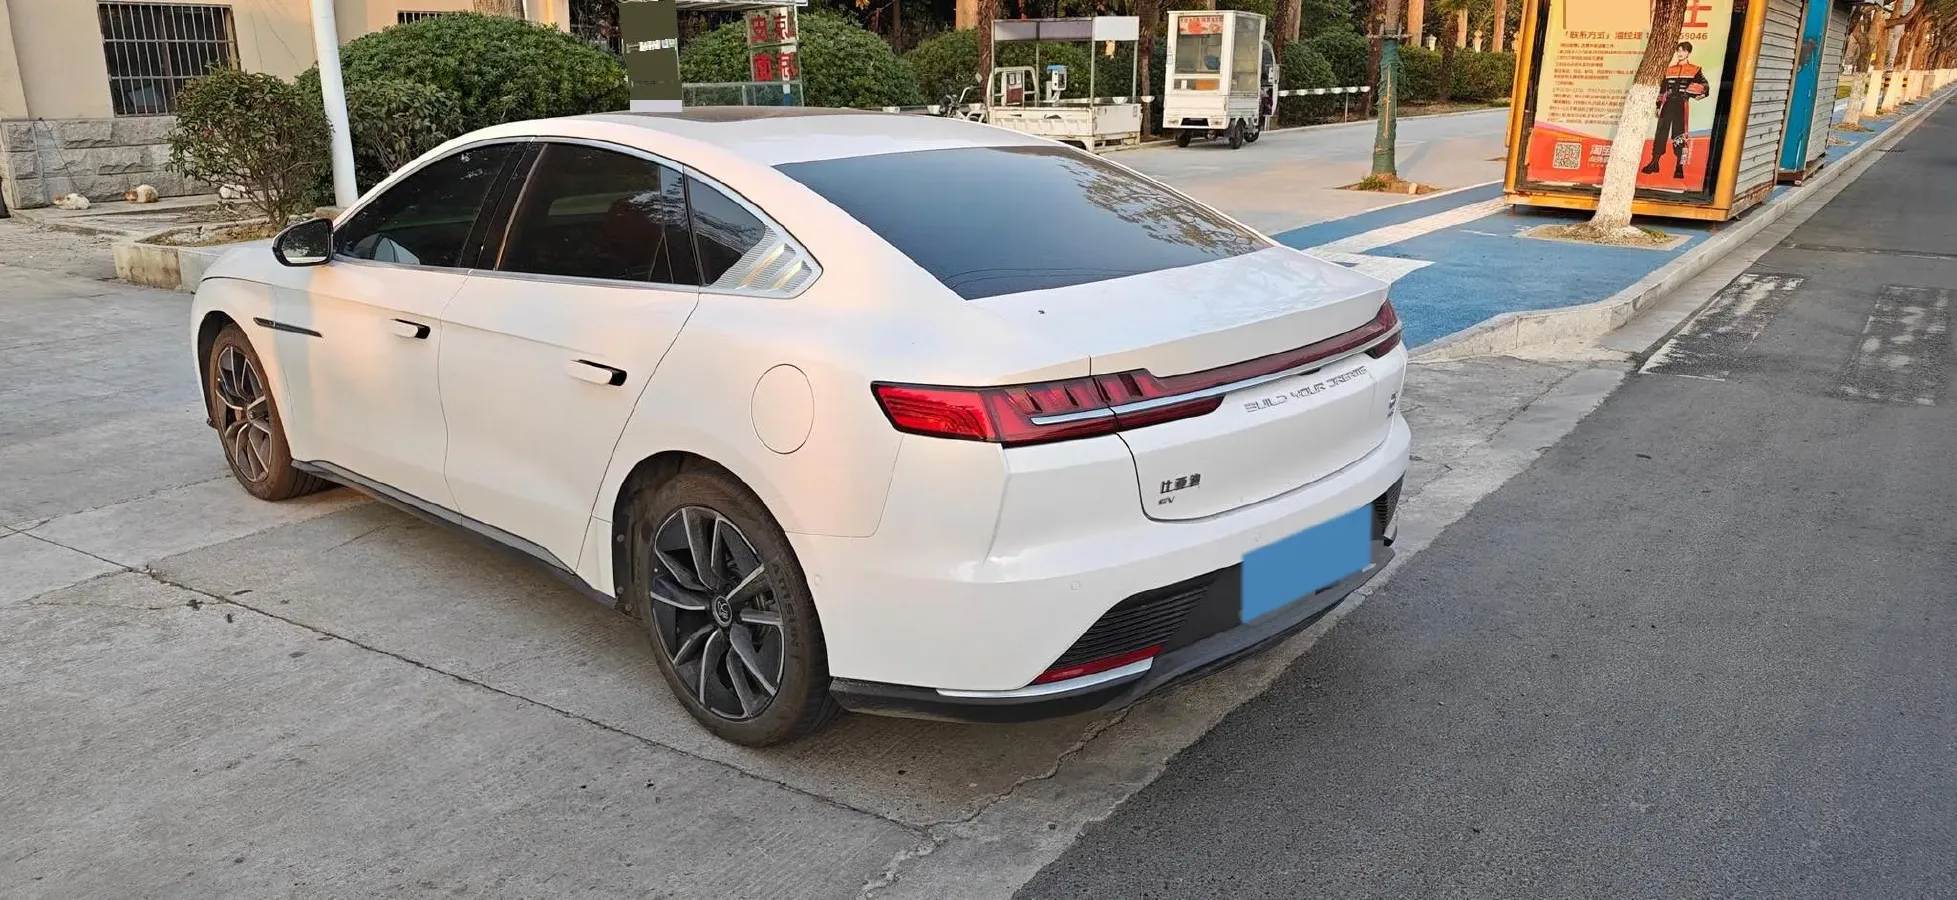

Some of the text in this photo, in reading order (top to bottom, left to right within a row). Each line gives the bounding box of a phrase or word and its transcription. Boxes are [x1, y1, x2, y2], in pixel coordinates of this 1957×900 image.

[1244, 365, 1367, 413] BUILD YOUR DREAMS
[1160, 473, 1201, 494] 比亚迪
